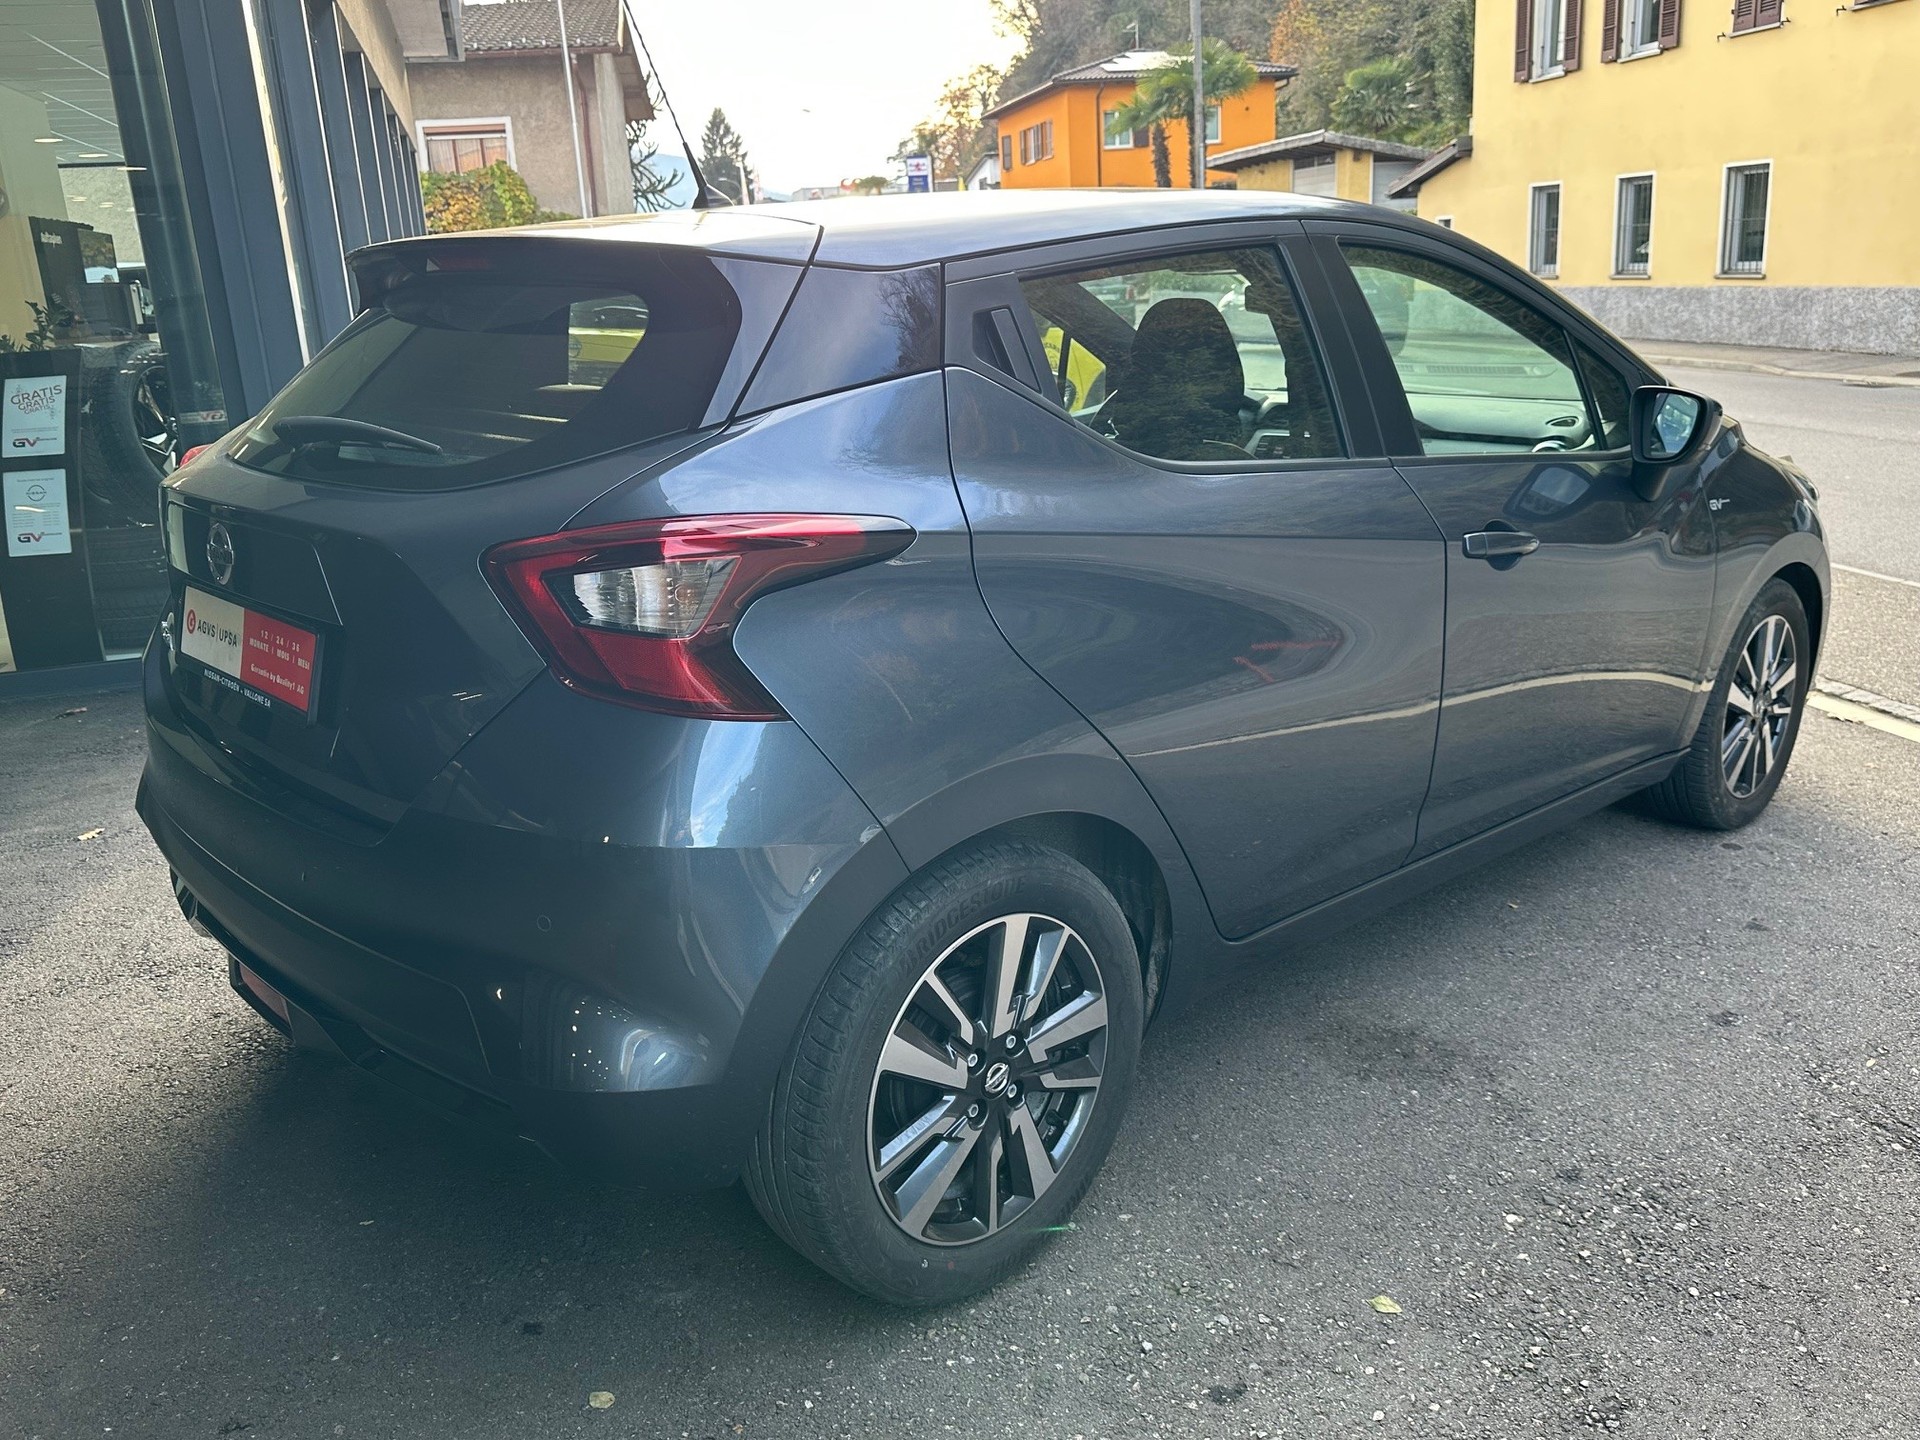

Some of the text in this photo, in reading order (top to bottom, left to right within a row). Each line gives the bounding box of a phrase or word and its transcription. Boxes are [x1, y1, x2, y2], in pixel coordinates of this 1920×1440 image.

[10, 384, 63, 405] GRATIS
[18, 395, 56, 411] GRATIS
[13, 437, 38, 448] GV
[18, 532, 42, 543] GV
[197, 619, 216, 638] AGVS
[218, 627, 237, 648] UPSA
[261, 629, 269, 640] 12
[275, 636, 284, 646] 24
[291, 642, 300, 652] 36
[269, 672, 276, 683] by
[296, 684, 305, 695] AG
[243, 687, 264, 705] VALLONE
[264, 698, 271, 708] SA
